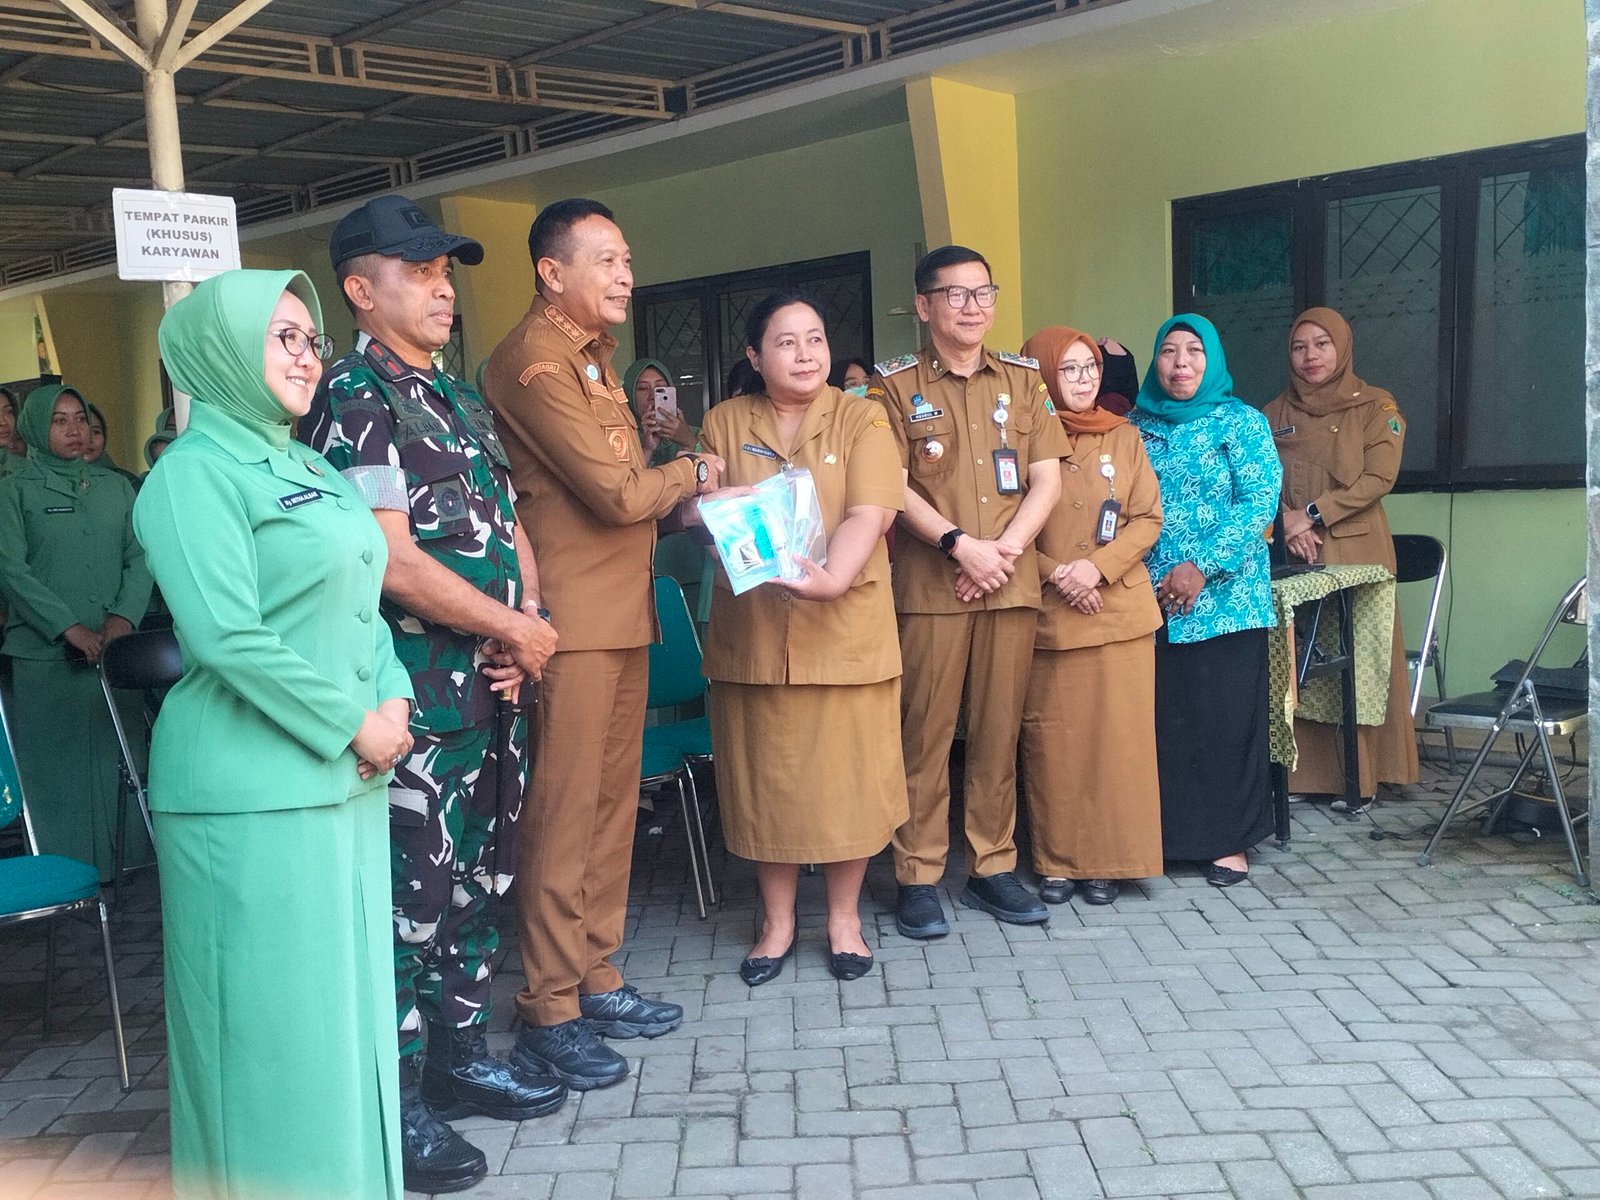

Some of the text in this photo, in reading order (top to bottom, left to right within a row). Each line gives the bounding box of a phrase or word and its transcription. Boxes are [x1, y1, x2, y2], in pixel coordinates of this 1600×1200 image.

[125, 211, 229, 226] TEMPAT PARKIR
[146, 228, 212, 244] (KHUSUS)
[141, 246, 219, 259] KARYAWAN
